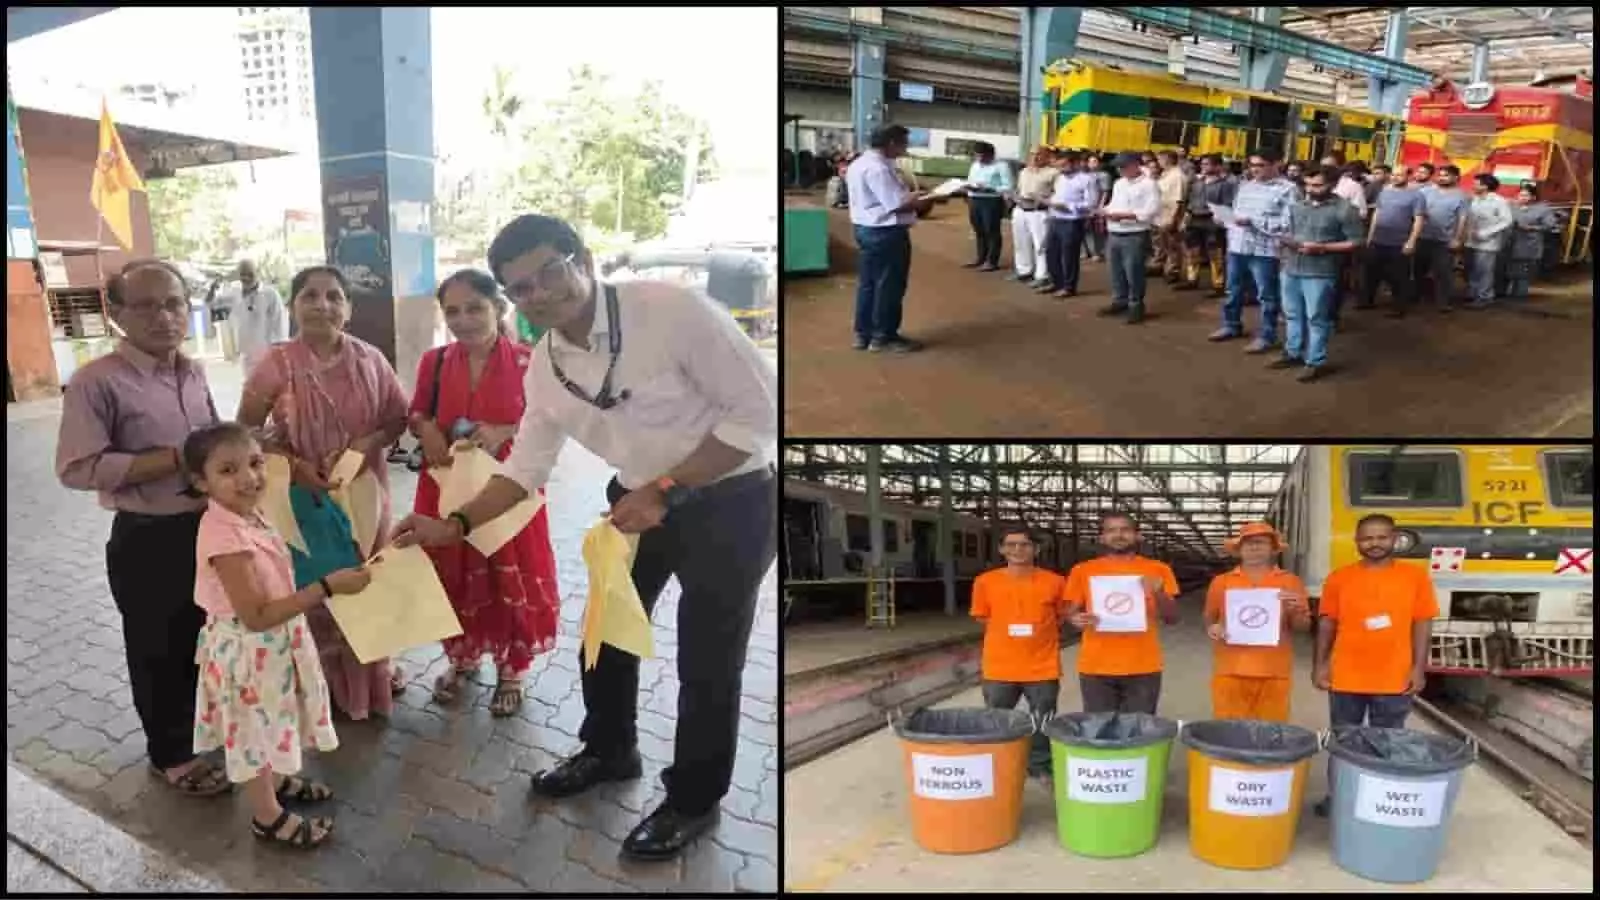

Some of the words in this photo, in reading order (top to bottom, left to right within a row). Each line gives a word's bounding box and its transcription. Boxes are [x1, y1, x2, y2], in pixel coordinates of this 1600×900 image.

[1471, 501, 1544, 525] ICF
[930, 765, 965, 777] NON
[1077, 766, 1135, 779] PLASTIC
[1080, 782, 1128, 794] WASTE
[1237, 781, 1267, 792] DRY
[1227, 794, 1273, 807] WASTE
[1386, 790, 1422, 802] WET
[1375, 803, 1425, 817] WASTE
